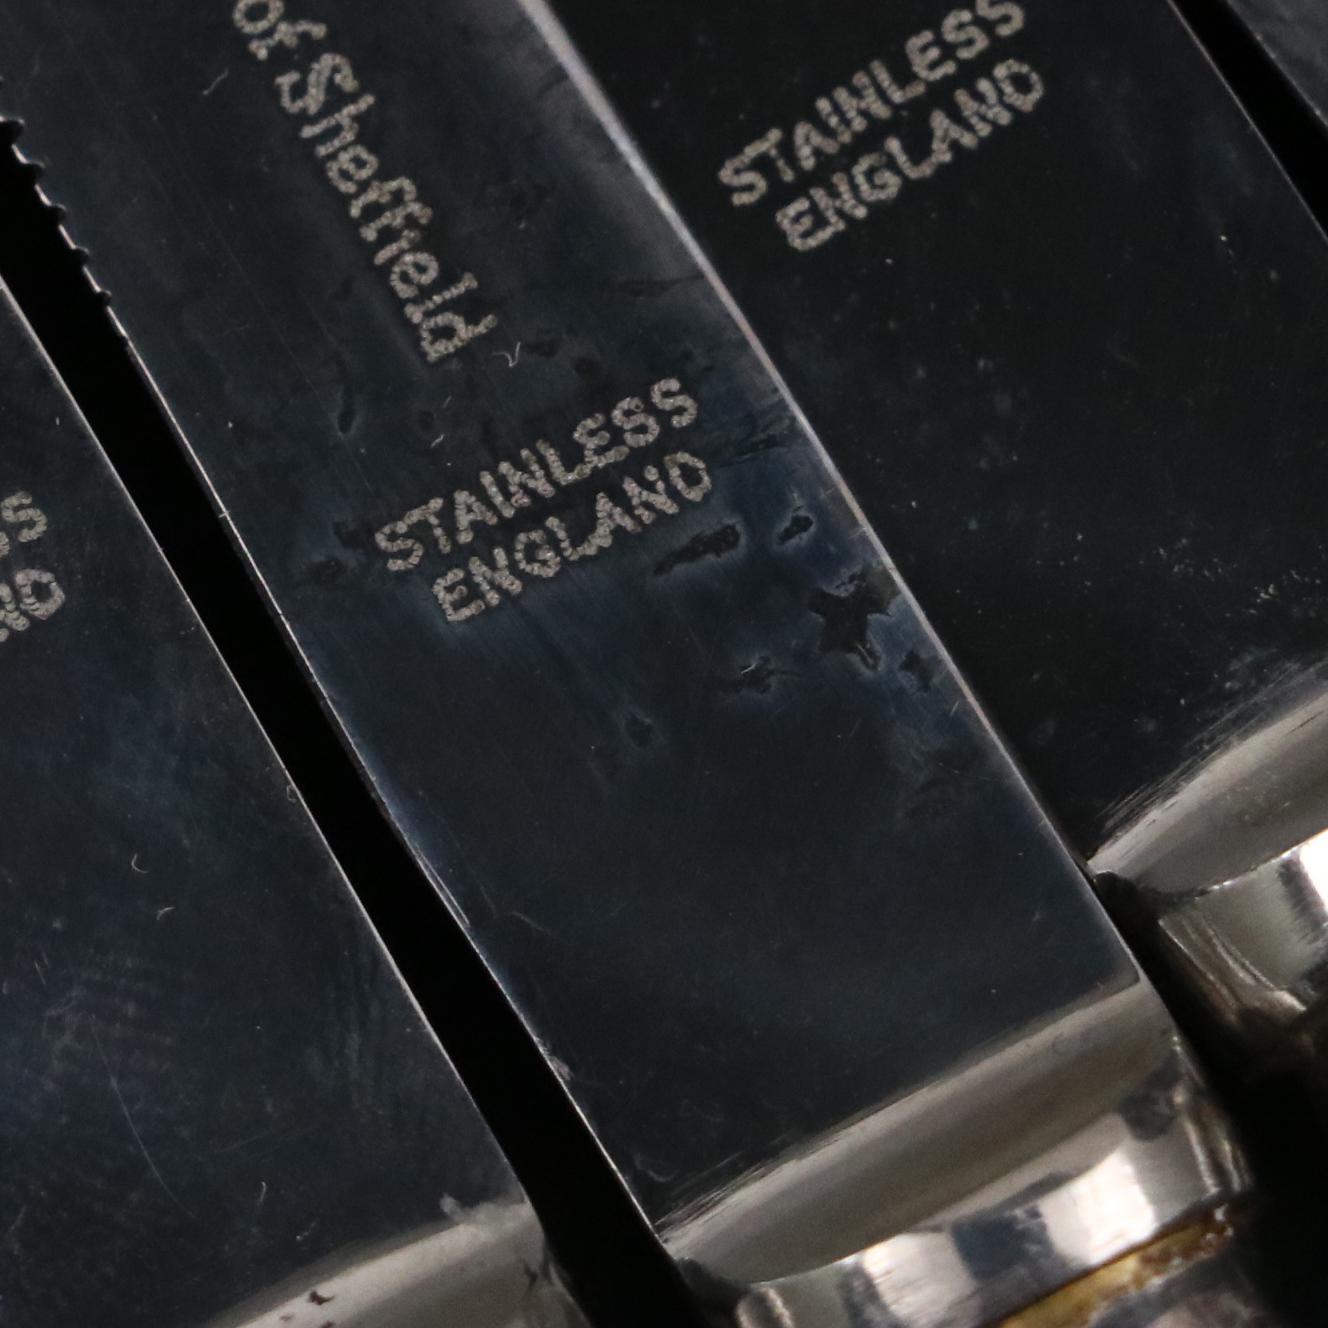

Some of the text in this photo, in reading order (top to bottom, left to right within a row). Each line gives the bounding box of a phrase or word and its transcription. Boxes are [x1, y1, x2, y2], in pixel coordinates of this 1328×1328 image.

[275, 52, 498, 364] Sheffield
[775, 59, 1045, 252] ENGLAND
[374, 378, 699, 573] STAINLESS
[431, 451, 712, 622] ENGLAND
